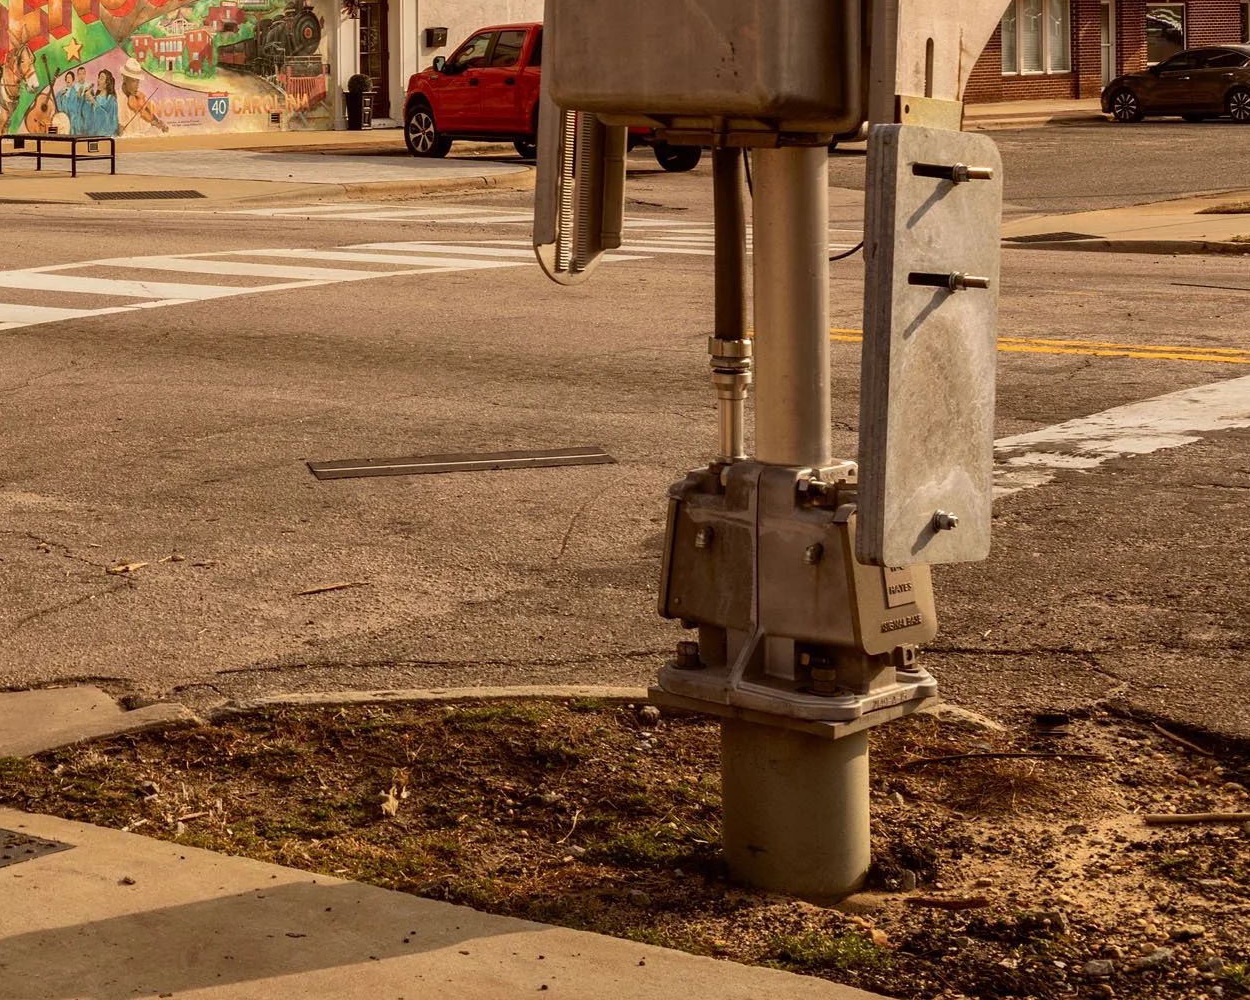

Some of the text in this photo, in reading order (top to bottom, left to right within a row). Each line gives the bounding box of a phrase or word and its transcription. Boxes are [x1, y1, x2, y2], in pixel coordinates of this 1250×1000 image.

[152, 93, 310, 118] NORTH 40 CAROLINA
[888, 582, 912, 595] HAYES
